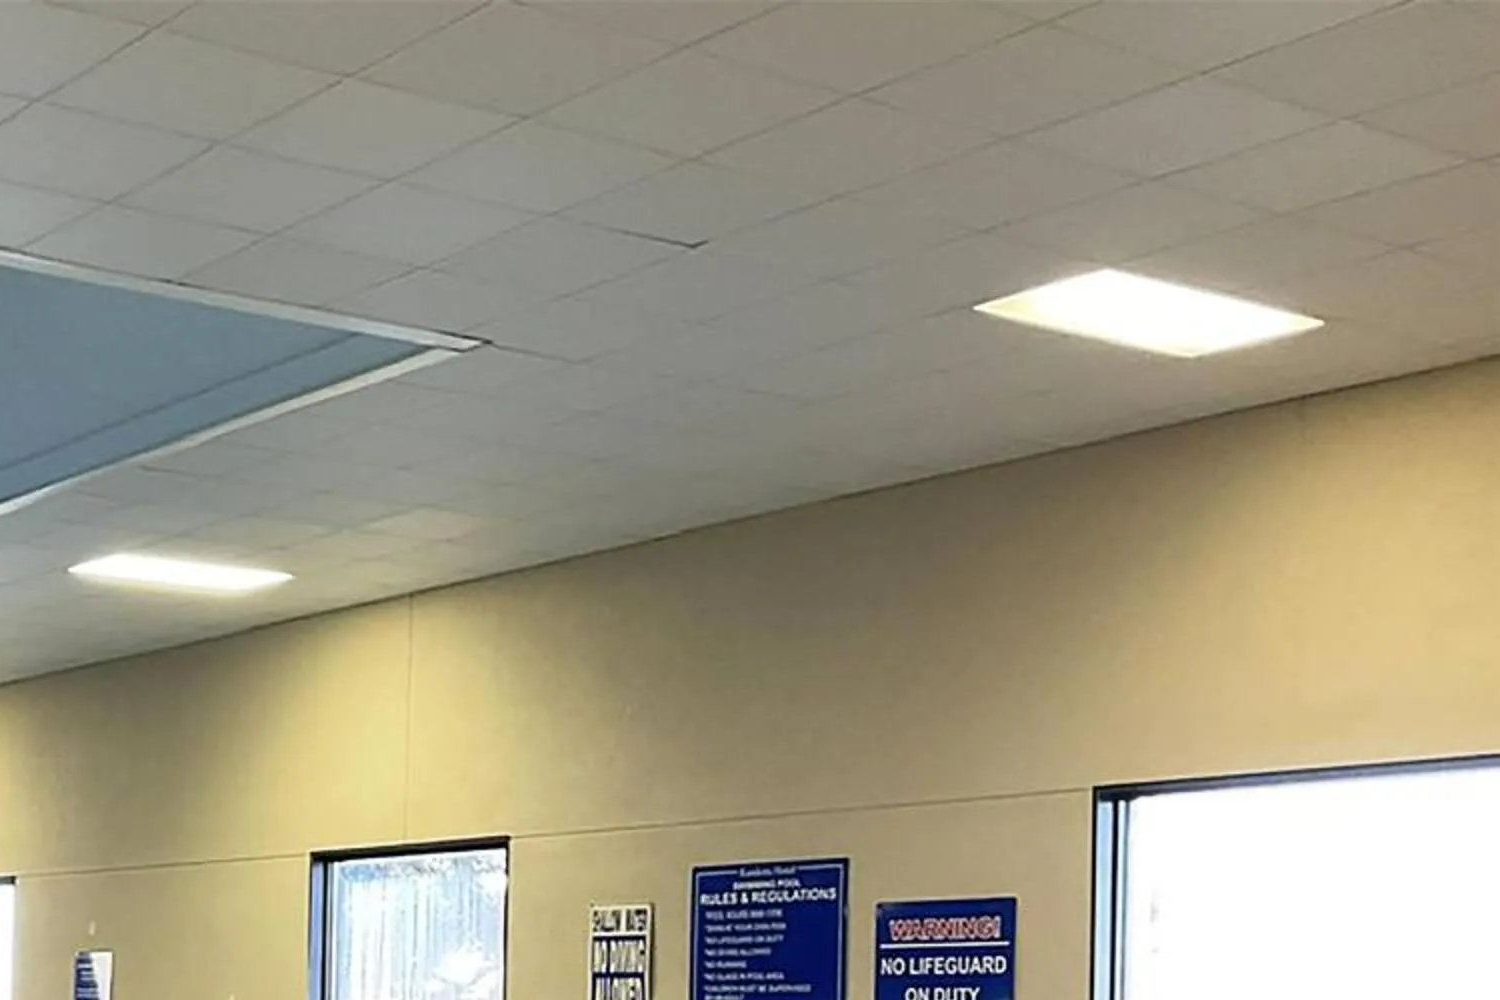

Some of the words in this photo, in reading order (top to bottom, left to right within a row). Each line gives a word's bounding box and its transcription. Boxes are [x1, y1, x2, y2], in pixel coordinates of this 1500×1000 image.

[700, 892, 737, 905] RULES
[741, 892, 749, 904] &
[751, 887, 837, 903] REGULATIONS
[889, 915, 1001, 940] WARNING!
[594, 940, 607, 973] NO
[609, 939, 646, 973] DIVING
[881, 958, 905, 975] NO
[909, 956, 1007, 975] LIFEGUARD
